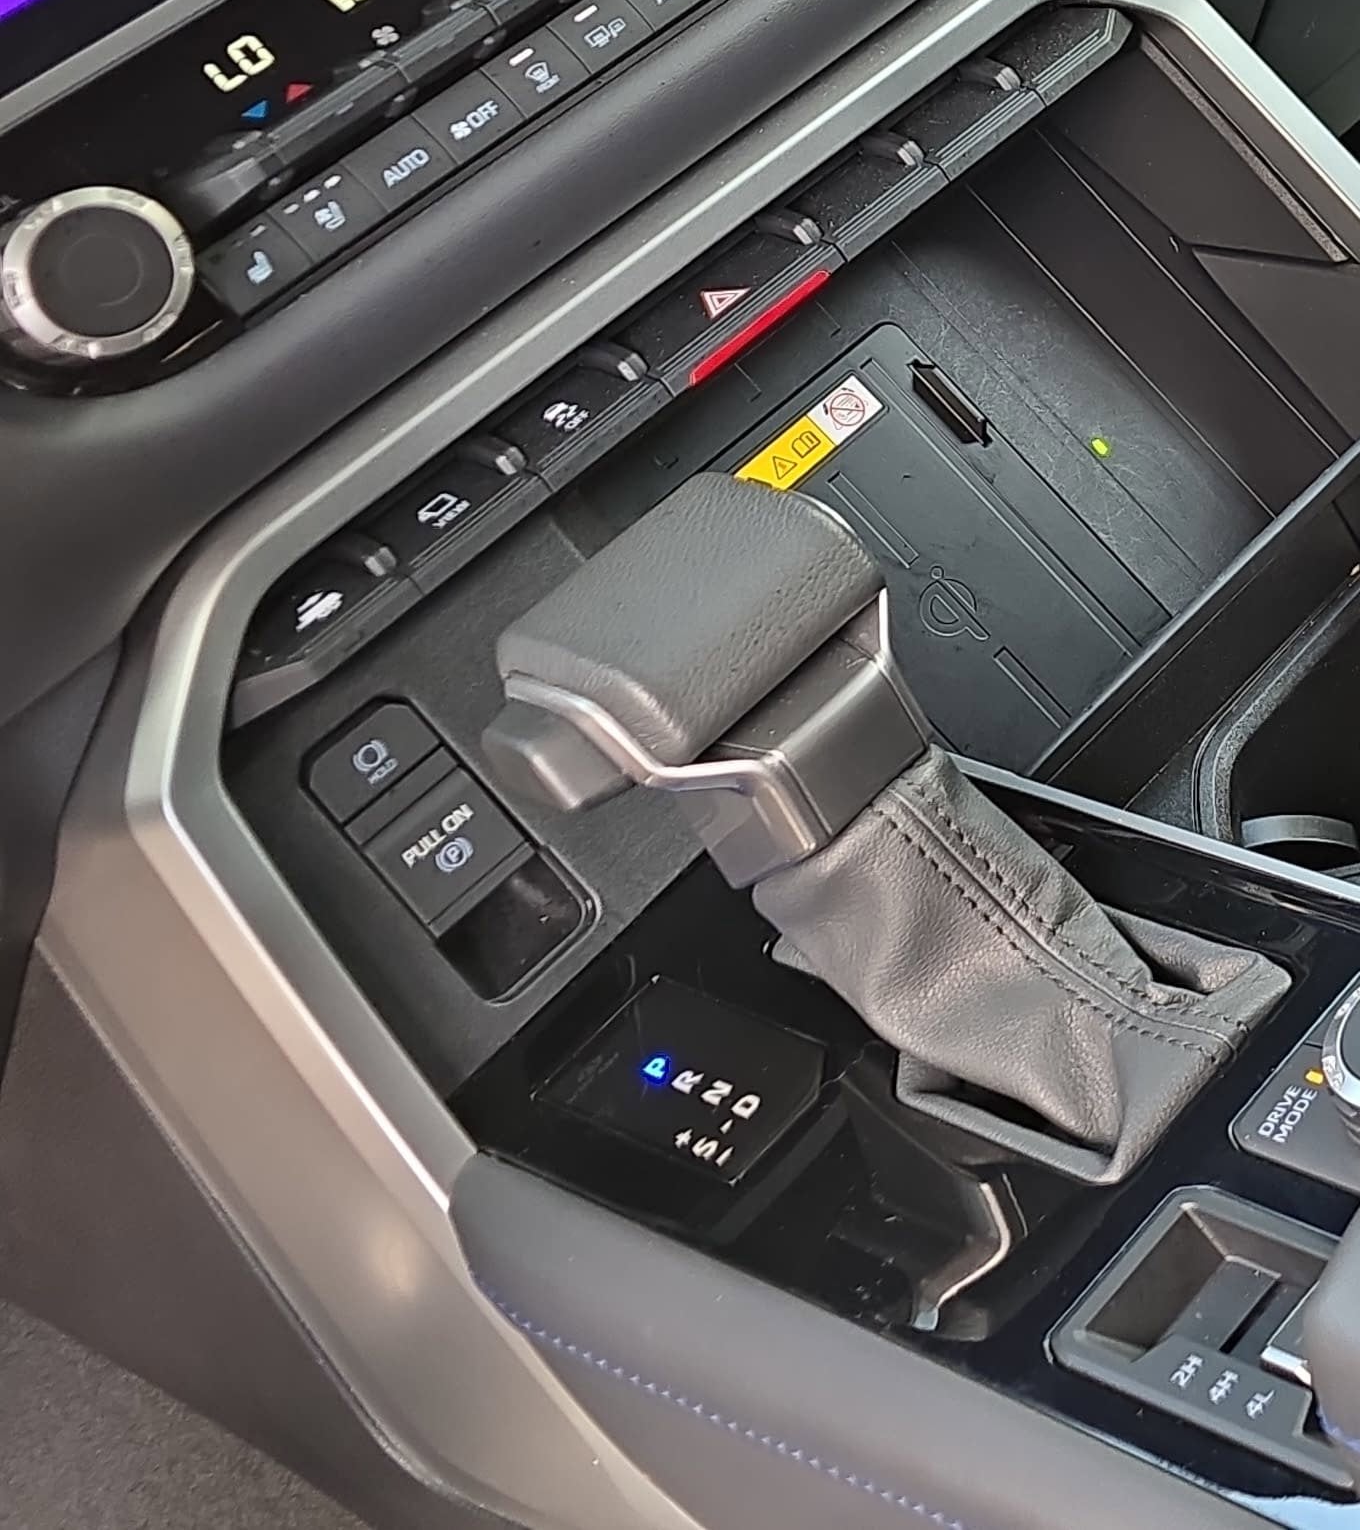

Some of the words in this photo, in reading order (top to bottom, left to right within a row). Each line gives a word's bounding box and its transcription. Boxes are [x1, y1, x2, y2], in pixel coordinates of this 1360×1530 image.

[466, 99, 500, 131] OFF
[382, 148, 431, 189] AUTO
[401, 829, 448, 869] PULL
[441, 803, 475, 835] ON
[642, 1056, 667, 1079] P
[671, 1069, 705, 1095] R
[700, 1079, 734, 1106] N
[731, 1093, 762, 1120] D
[1257, 1084, 1302, 1138] DRIVE
[1271, 1087, 1319, 1144] MODE
[1168, 1353, 1204, 1389] 2H
[1207, 1369, 1240, 1406] 4H
[1245, 1389, 1276, 1421] 4L
